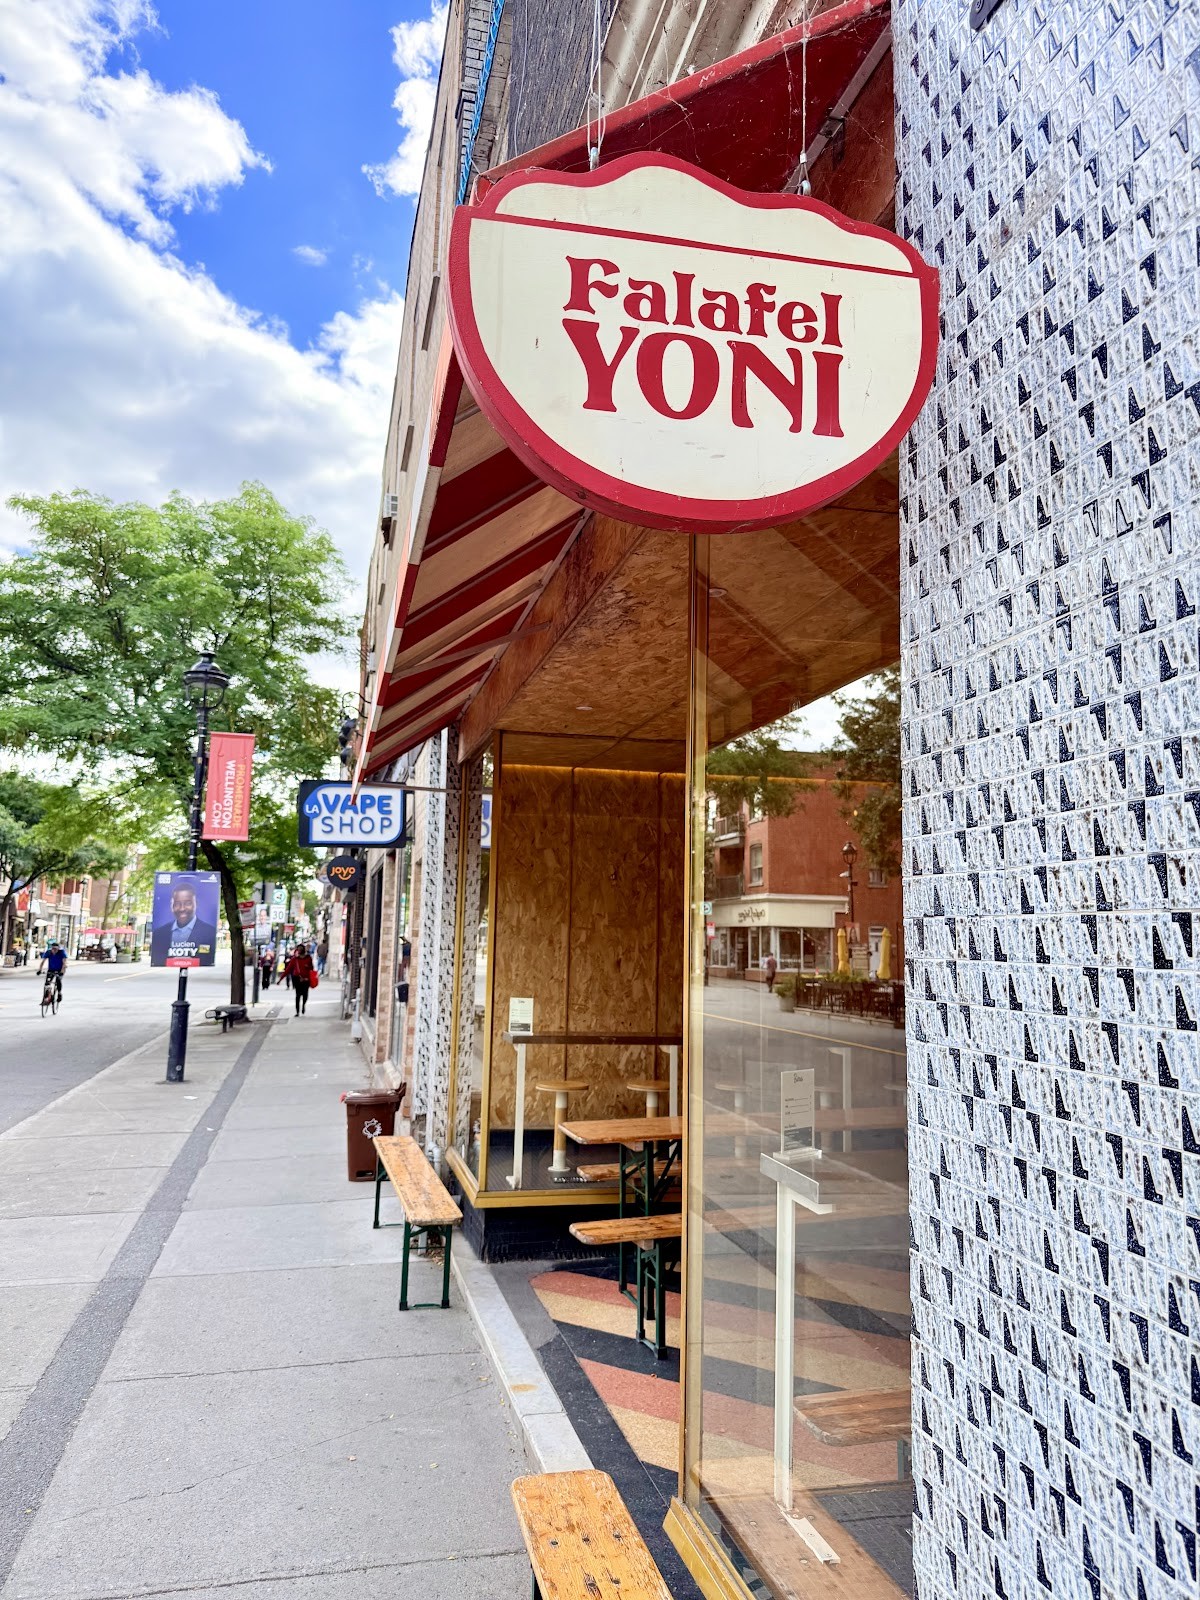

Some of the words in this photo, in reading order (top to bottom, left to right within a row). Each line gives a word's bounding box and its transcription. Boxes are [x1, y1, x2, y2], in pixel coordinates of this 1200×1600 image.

[562, 255, 843, 348] Falafel
[562, 318, 844, 438] YONI
[221, 760, 236, 829] WELLINGTON
[233, 764, 246, 829] PROMENADE
[305, 804, 320, 814] LA
[321, 793, 393, 815] VAPE
[212, 800, 222, 828] .COM
[321, 816, 393, 834] SHOP
[272, 910, 285, 920] 30
[168, 947, 198, 957] KOTY
